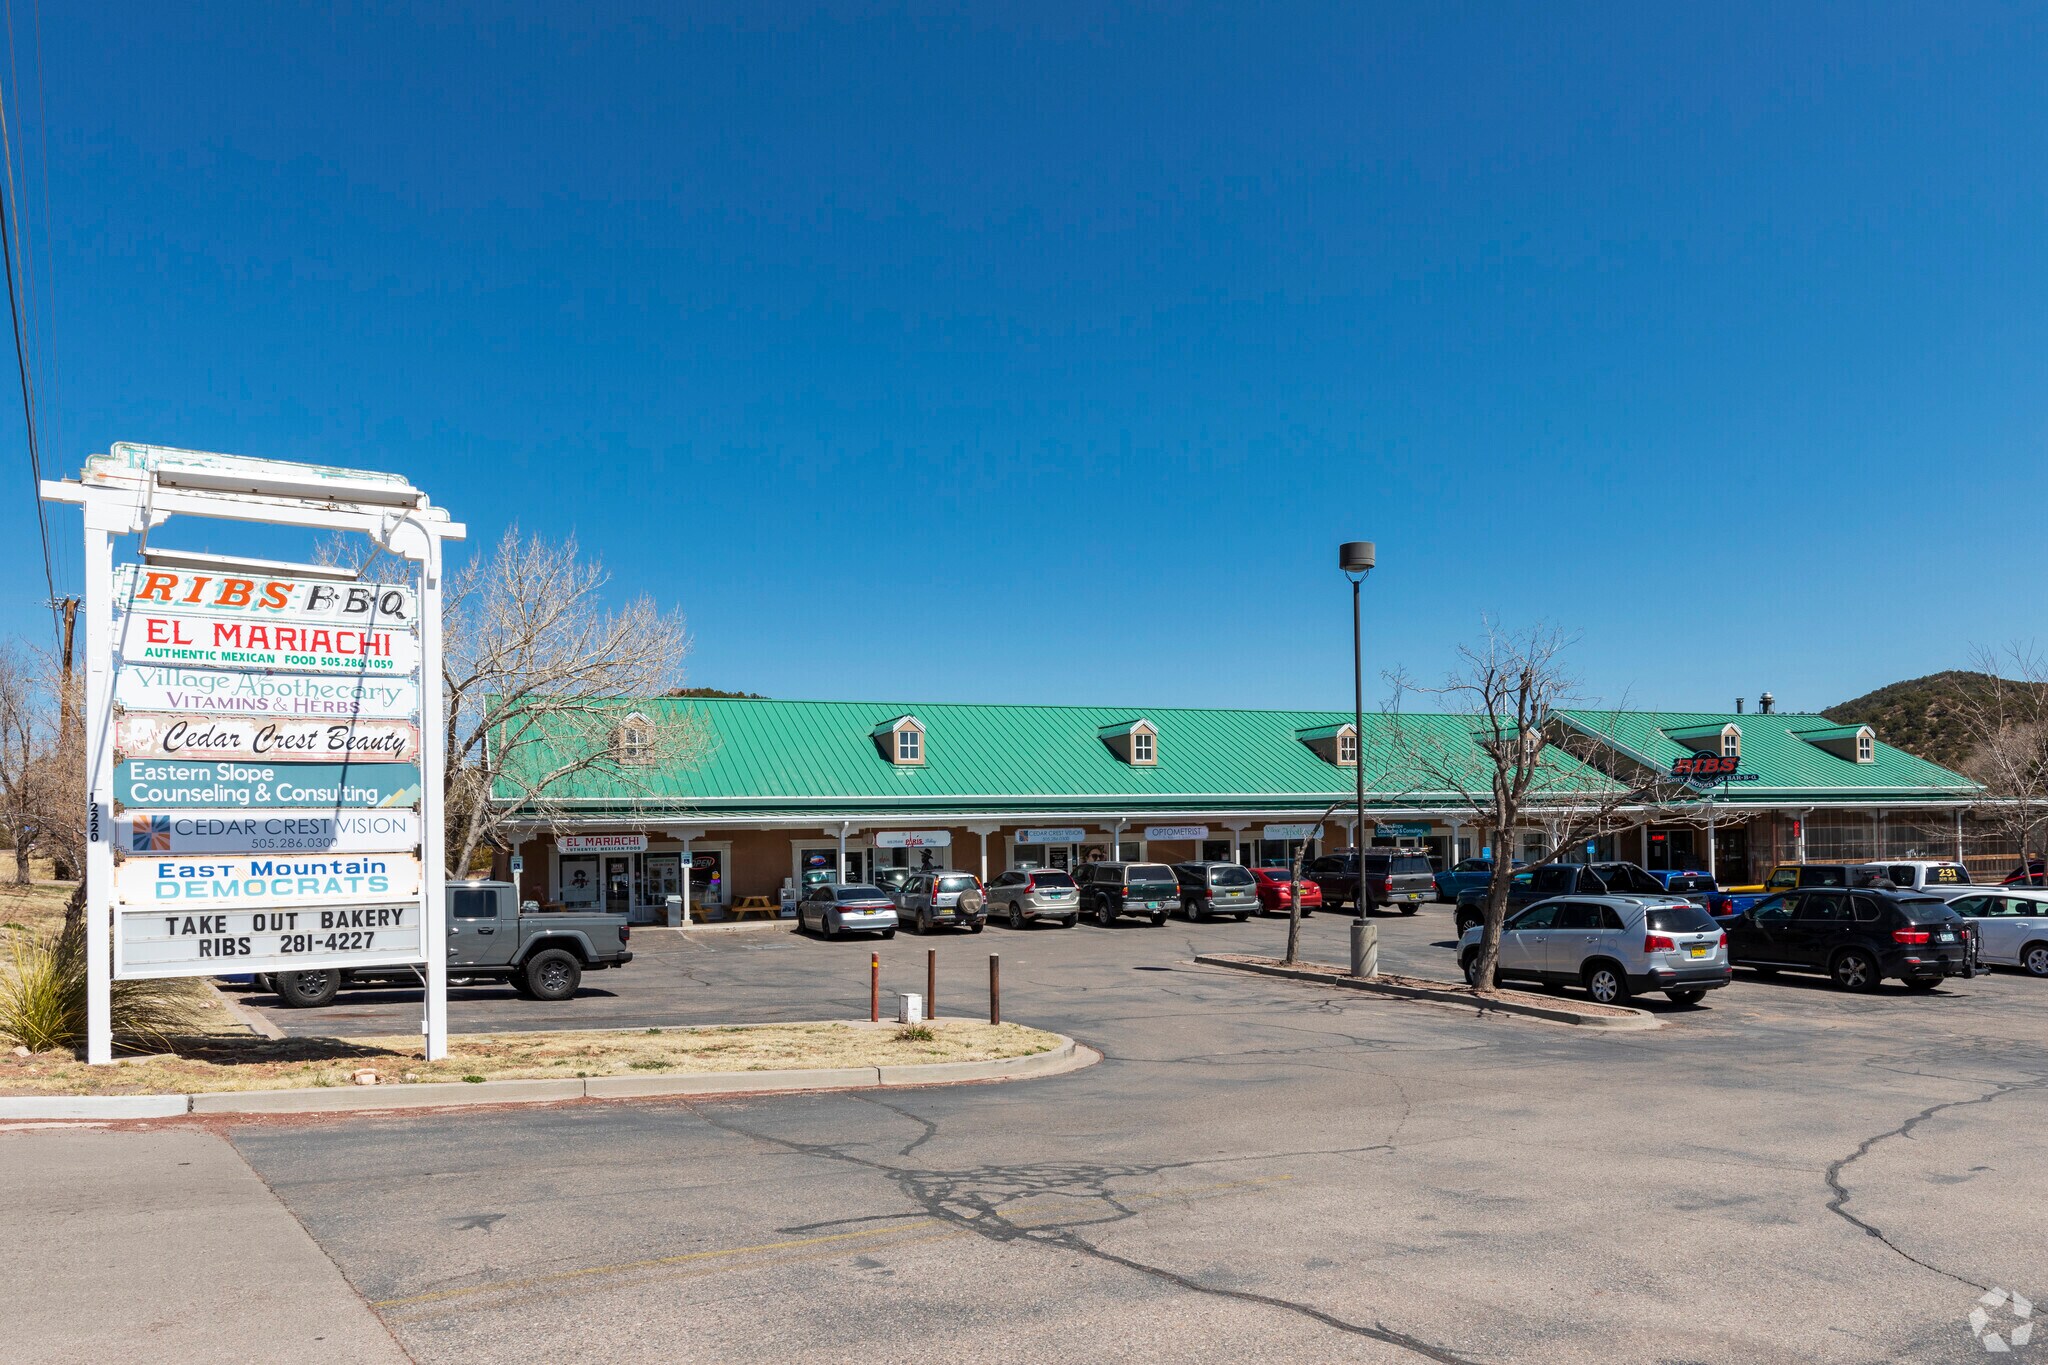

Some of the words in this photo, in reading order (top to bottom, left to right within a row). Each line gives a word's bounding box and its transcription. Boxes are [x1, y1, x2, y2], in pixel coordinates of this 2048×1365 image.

[135, 571, 295, 610] RIBS
[146, 618, 192, 645] EL
[213, 622, 392, 657] MARIACHI
[145, 647, 217, 662] AUTHENTIC
[221, 651, 276, 664] MEXICAN
[285, 654, 316, 666] FOOD
[320, 656, 394, 670] 505.286.1059
[133, 667, 230, 695] Village
[231, 671, 403, 709] Apothecary
[166, 691, 269, 711] VITAMINS
[272, 696, 289, 712] &
[293, 697, 361, 715] HERBS
[162, 720, 241, 753] Cedar
[252, 723, 318, 754] Crest
[327, 725, 407, 759] Beauty
[130, 762, 211, 782] Eastern
[216, 762, 275, 784] Slope
[1674, 757, 1738, 774] RIBS
[130, 783, 250, 806] Counseling
[255, 783, 271, 803] &
[276, 782, 379, 806] Consulting
[90, 792, 99, 842] 12220
[175, 818, 257, 836] CEDAR
[264, 817, 333, 835] CREST
[335, 817, 406, 834] VISION
[251, 836, 339, 850] 505.286.0300
[566, 837, 580, 846] EL
[585, 836, 640, 847] MARIACHI
[1152, 827, 1202, 836] OPTOMETRIST
[158, 862, 235, 879] East
[251, 857, 386, 877] Mountain
[1938, 868, 1957, 877] 231
[155, 875, 389, 900] DEMOCRATS
[165, 915, 227, 936] TAKE
[252, 911, 299, 932] OUT
[321, 908, 405, 930] BAKERY
[199, 937, 252, 958] RIBS
[280, 931, 376, 954] 281-4227
